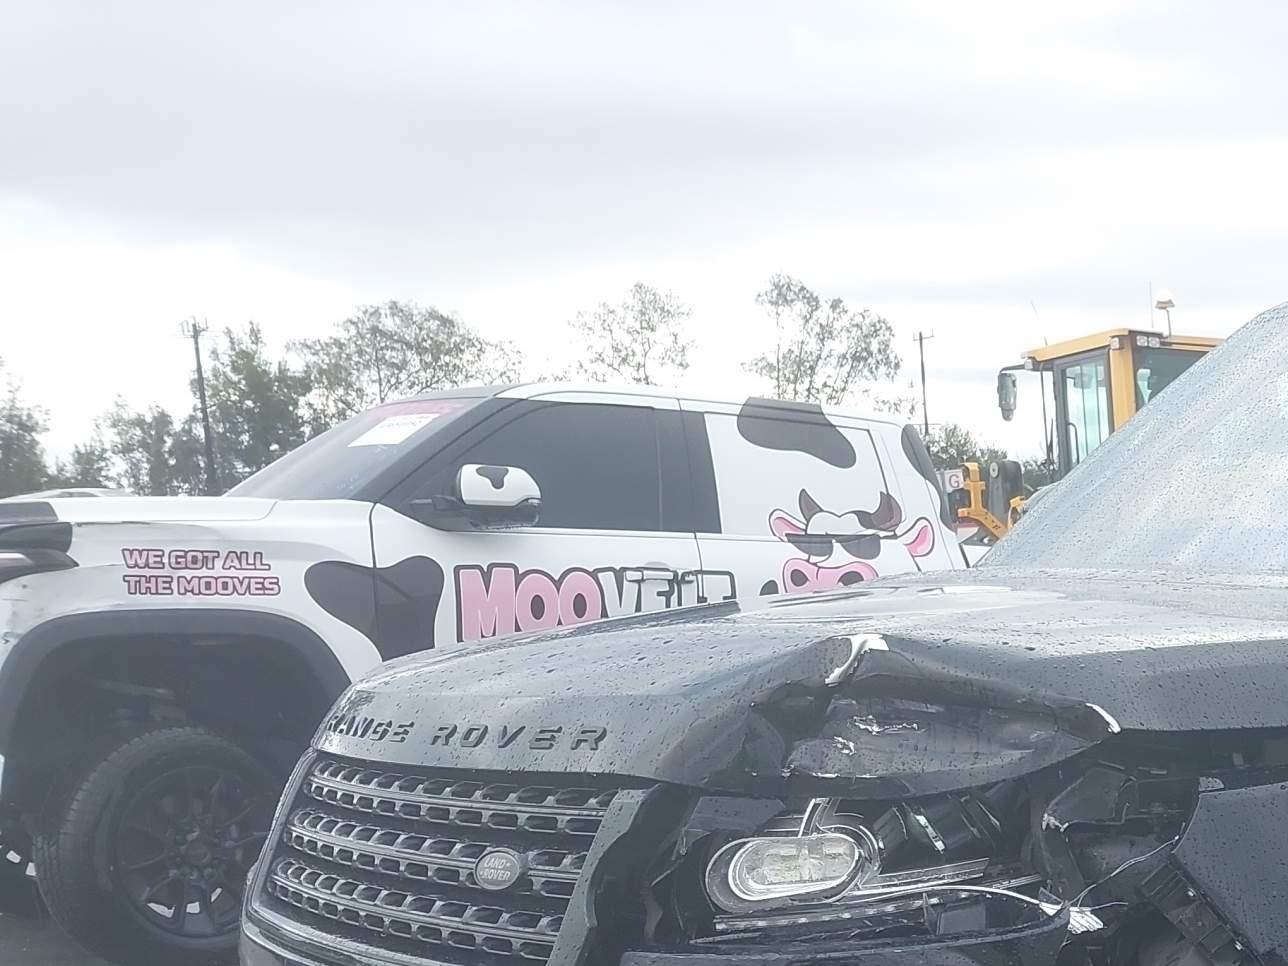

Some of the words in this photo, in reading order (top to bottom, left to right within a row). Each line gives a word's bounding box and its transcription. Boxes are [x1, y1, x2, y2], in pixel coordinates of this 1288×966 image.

[122, 548, 164, 570] WE
[168, 549, 220, 571] GOT
[222, 551, 271, 571] ALL
[123, 575, 174, 596] THE
[177, 576, 281, 597] MOOVES
[327, 713, 415, 742] RANGE
[432, 723, 608, 750] ROVER
[484, 857, 506, 868] LAND
[483, 868, 511, 881] ROVER
